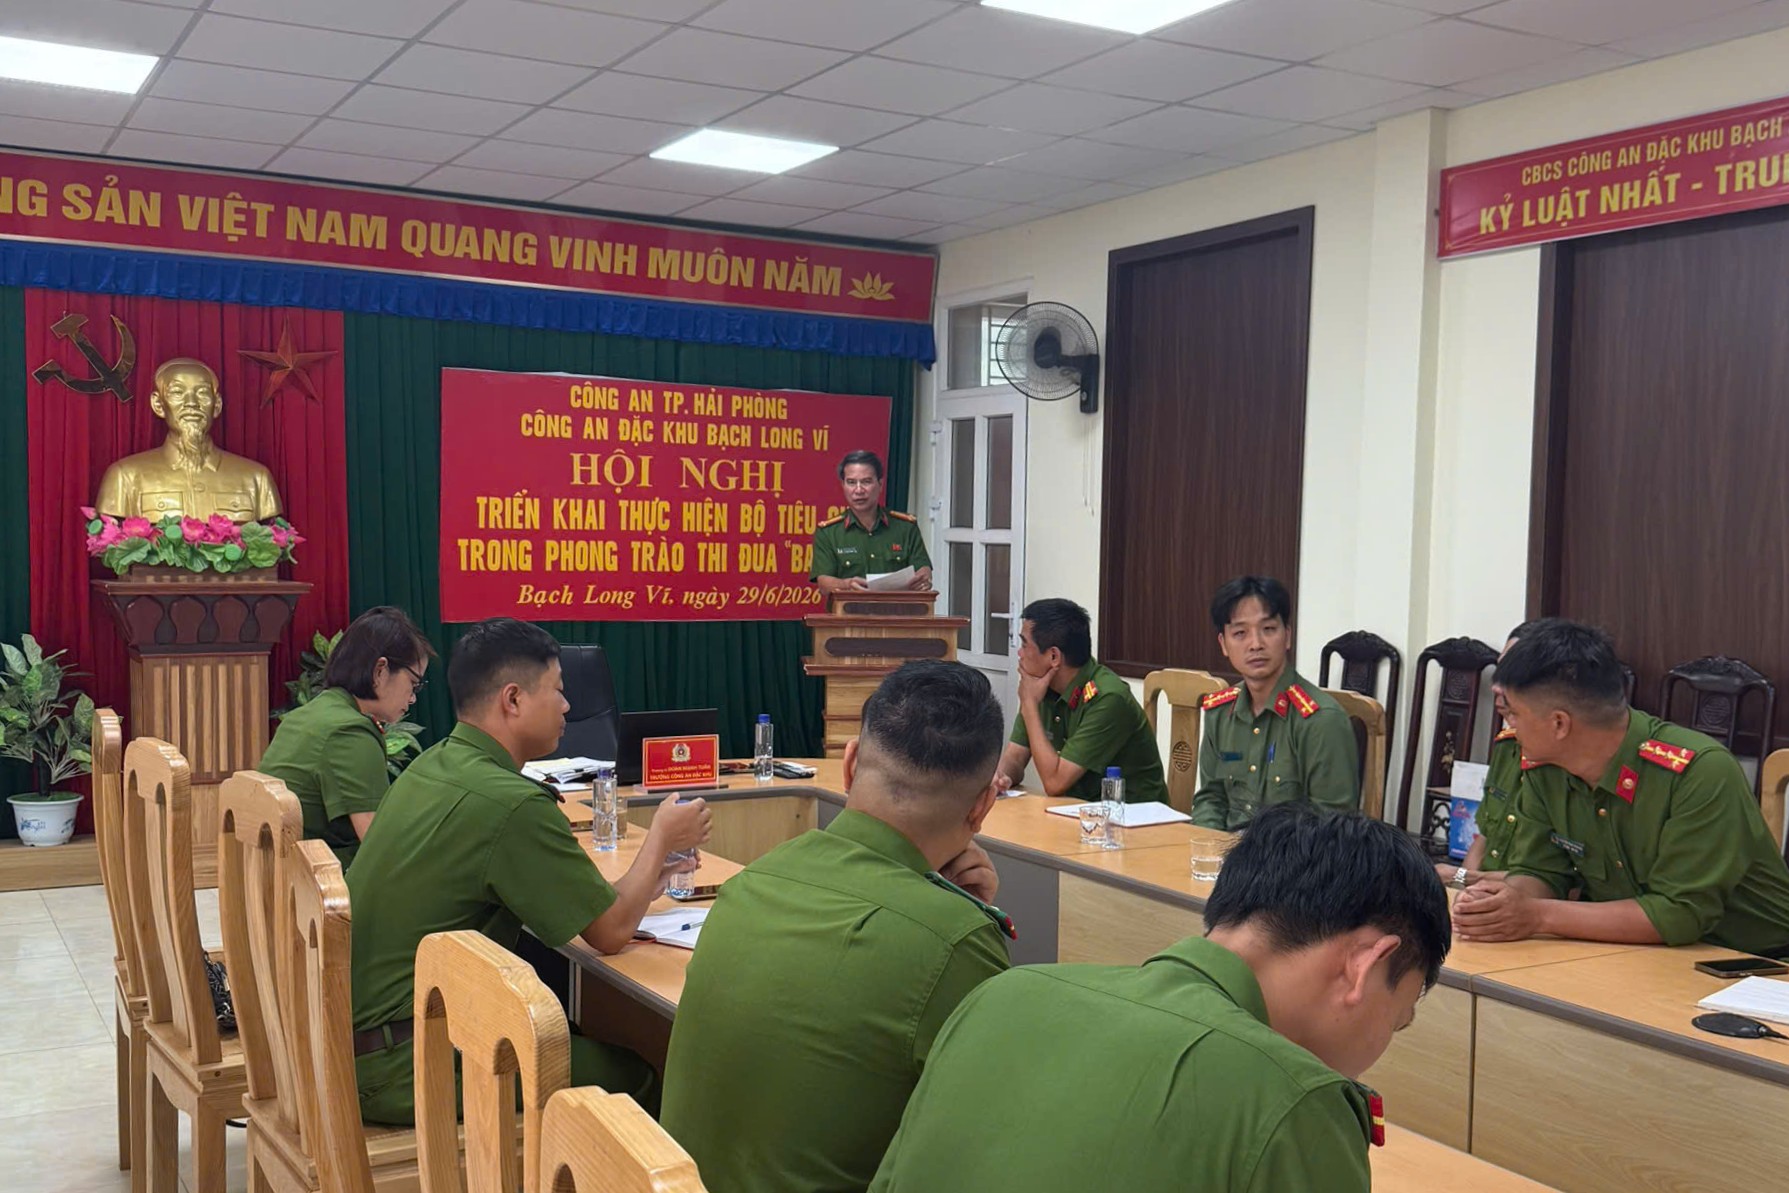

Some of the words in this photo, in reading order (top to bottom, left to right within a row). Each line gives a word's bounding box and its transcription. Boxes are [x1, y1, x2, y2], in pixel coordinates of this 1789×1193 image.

[1521, 160, 1563, 186] CBCS
[1567, 150, 1612, 177] CÔNG
[1616, 144, 1641, 168] AN
[1646, 135, 1682, 167] ĐẶC
[1687, 127, 1725, 155] KHU
[1730, 115, 1784, 148] BẠCH
[1479, 193, 1514, 235] KỶ
[1522, 186, 1591, 228] LUẬT
[1599, 163, 1682, 215] NHẤT
[1713, 151, 1789, 196] TRU
[61, 174, 162, 228] SẢN
[177, 191, 275, 242] VIỆT
[285, 205, 388, 250] NAM
[400, 218, 538, 268] QUANG
[548, 234, 638, 277] VINH
[647, 246, 755, 288] MUÔN
[763, 255, 843, 297] NĂM
[569, 380, 620, 411] CÔNG
[628, 388, 654, 413] AN
[693, 387, 723, 417] HẢI
[730, 390, 789, 420] PHÒNG
[520, 408, 573, 439] CÔNG
[582, 416, 609, 441] AN
[617, 415, 654, 447] ĐẶC
[662, 420, 699, 445] KHU
[706, 423, 752, 451] BẠCH
[760, 426, 804, 450] LONG
[812, 424, 830, 451] VĨ
[569, 448, 653, 494] HỘI
[678, 456, 786, 500] NGHỊ
[476, 488, 540, 530] TRIỂN
[552, 497, 606, 531] KHAI
[618, 496, 671, 536] THỰC
[682, 496, 728, 537] HIỆN
[739, 498, 766, 538] BỘ
[777, 499, 817, 535] TIÊU
[457, 538, 533, 572] TRONG
[545, 539, 619, 572] PHONG
[630, 535, 685, 573] TRÀO
[697, 542, 728, 573] THI
[738, 542, 778, 573] ĐUA
[516, 584, 574, 608] Bạch
[583, 584, 636, 609] Long
[646, 584, 674, 605] Vĩ,
[682, 586, 730, 610] ngày
[735, 582, 822, 607] 29/6/2026
